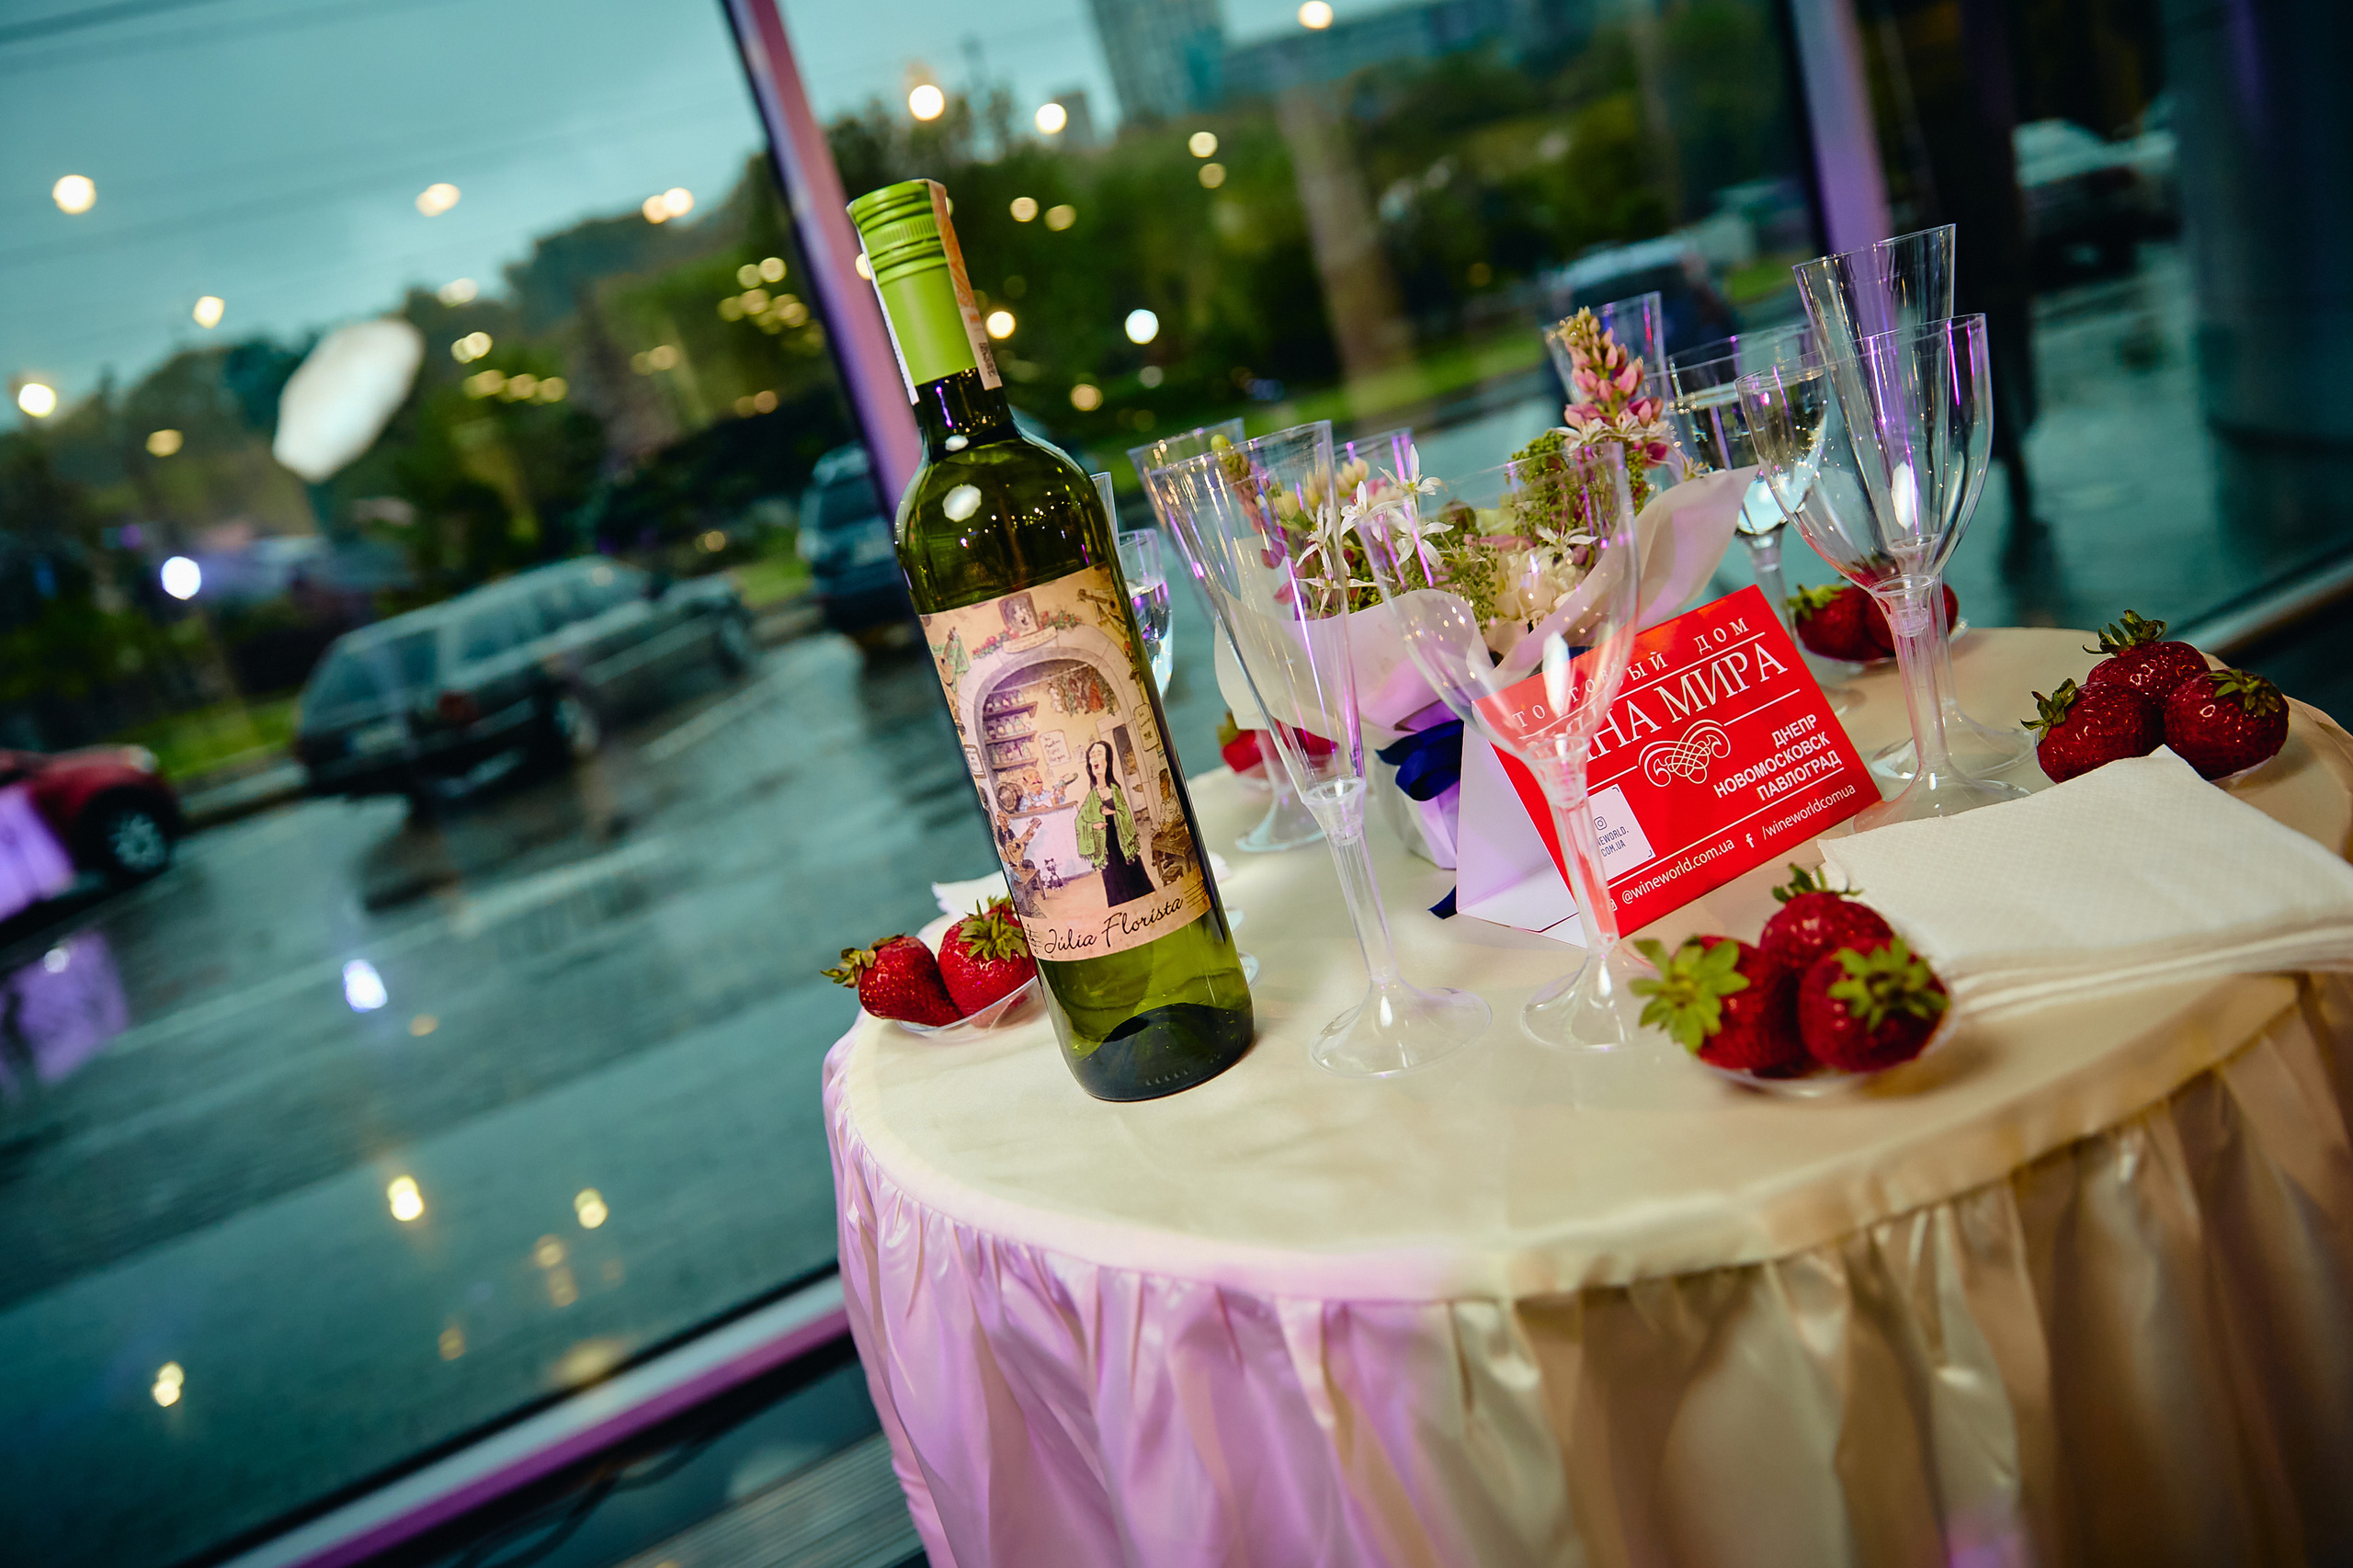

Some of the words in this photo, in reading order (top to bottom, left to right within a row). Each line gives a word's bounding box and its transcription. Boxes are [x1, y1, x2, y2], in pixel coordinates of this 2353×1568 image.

[1693, 617, 1749, 655] ДОМ
[1653, 642, 1789, 724] МИРА
[1771, 713, 1818, 749] ДНЕПР
[1712, 731, 1831, 799] НОВОМОСКОВСК
[1756, 749, 1843, 801] ПАВЛОГРАД
[1597, 825, 1630, 846] EWORLD.
[1600, 839, 1627, 858] COM.UA
[1621, 837, 1735, 905] @wineworld.com.ua
[1761, 784, 1857, 840] /wineworldcomua
[1044, 928, 1098, 954] Júlia
[1101, 896, 1184, 949] Florista
